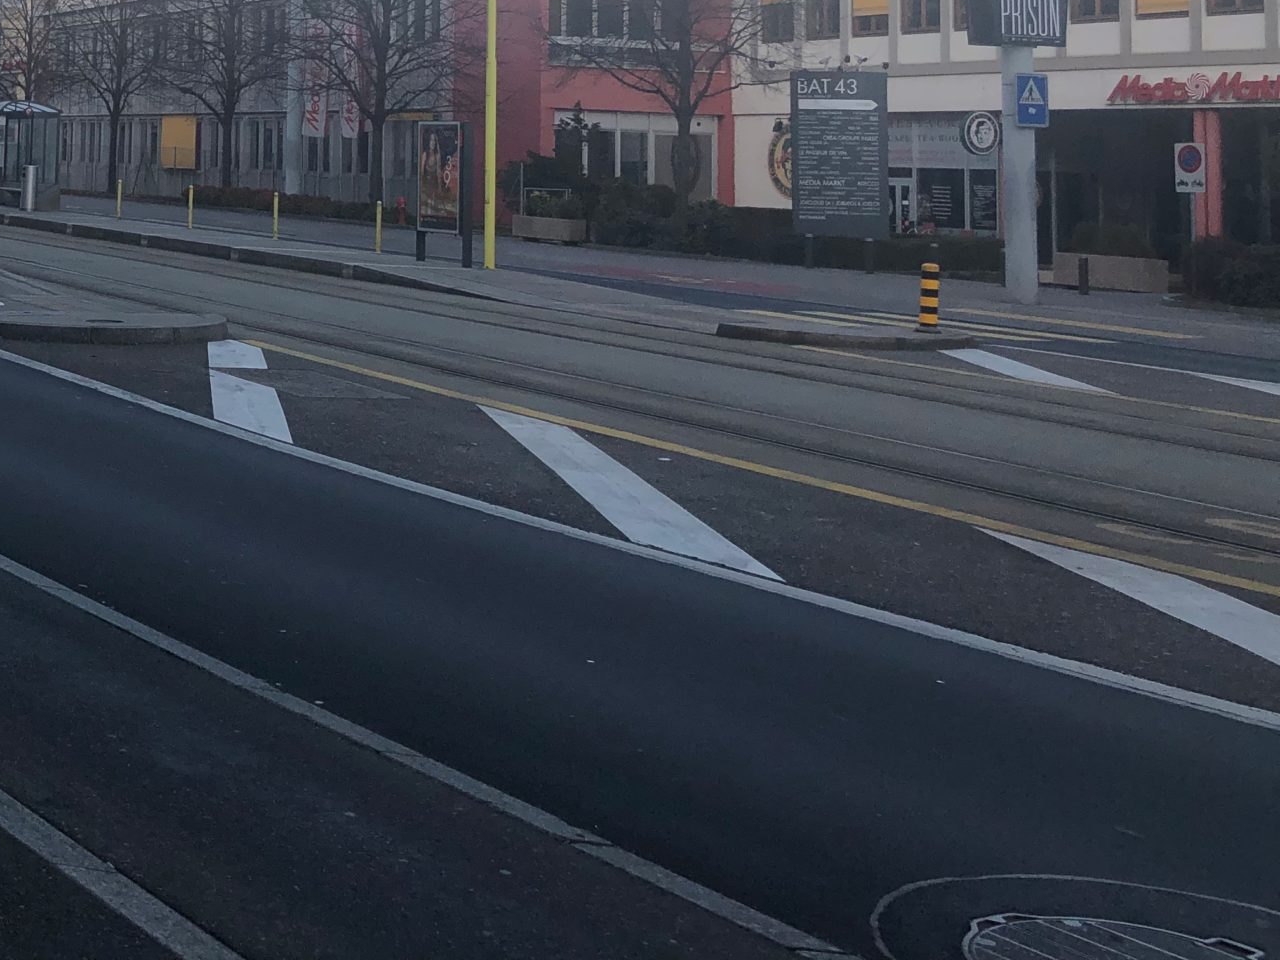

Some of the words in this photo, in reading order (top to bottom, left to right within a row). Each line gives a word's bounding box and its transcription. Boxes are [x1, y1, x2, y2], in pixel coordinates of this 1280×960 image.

[797, 78, 832, 94] BAT
[835, 78, 857, 95] 43
[1106, 74, 1187, 102] Media
